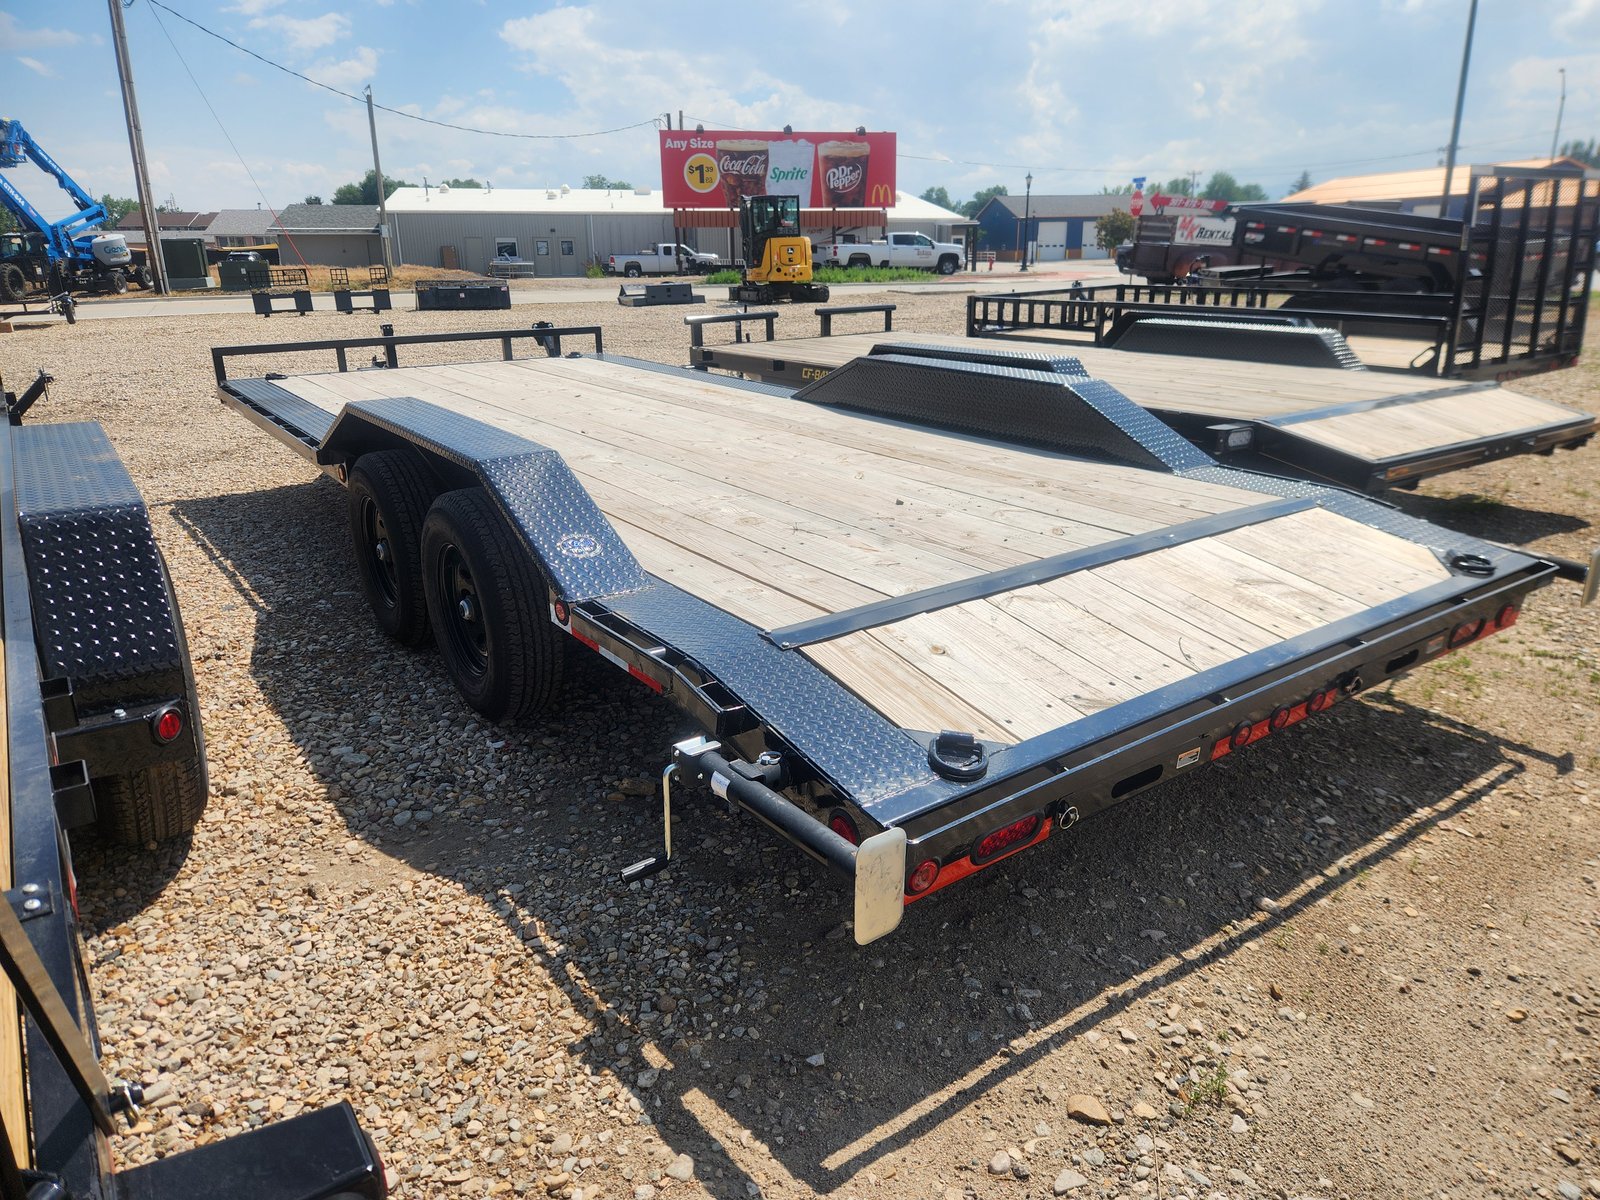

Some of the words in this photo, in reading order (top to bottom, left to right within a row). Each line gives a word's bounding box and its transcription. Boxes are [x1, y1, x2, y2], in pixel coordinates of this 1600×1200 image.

[665, 138, 687, 151] Any
[689, 138, 714, 149] Size
[770, 166, 808, 183] Sprite
[827, 168, 861, 189] Pepper
[839, 165, 853, 177] Dr
